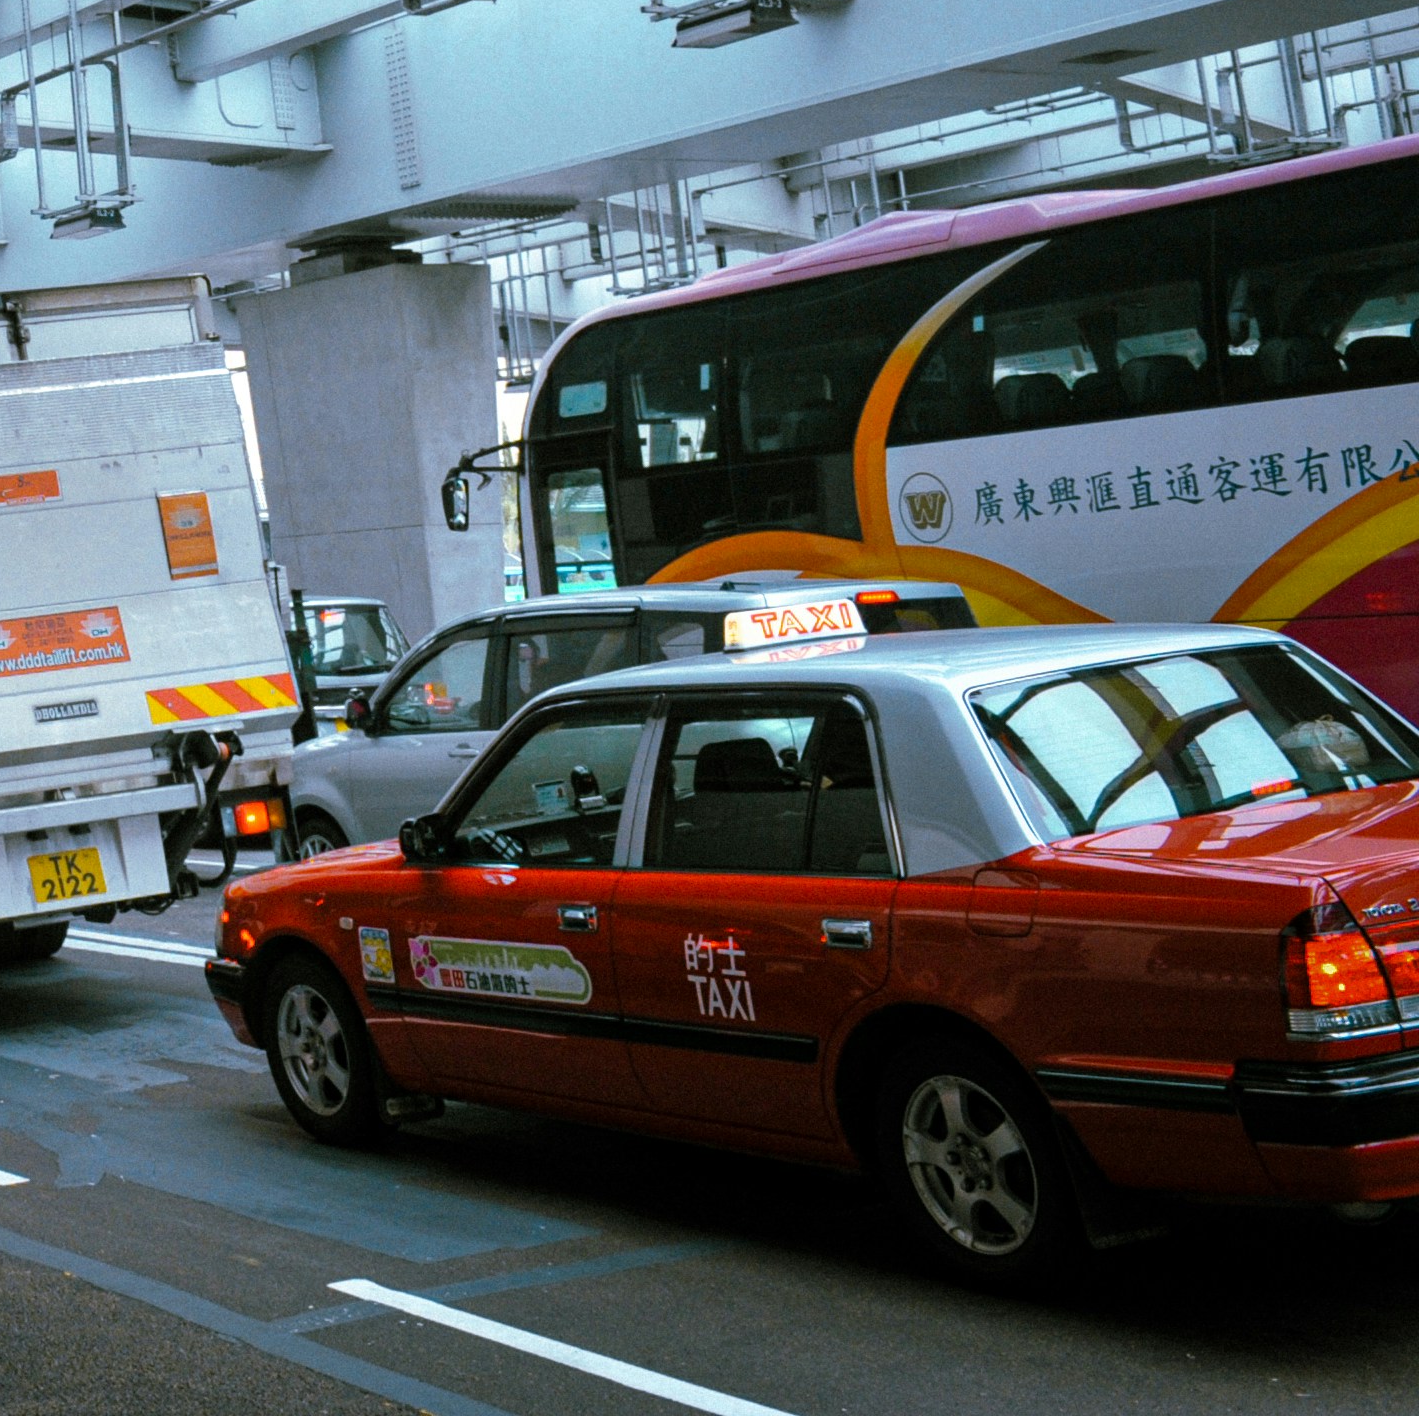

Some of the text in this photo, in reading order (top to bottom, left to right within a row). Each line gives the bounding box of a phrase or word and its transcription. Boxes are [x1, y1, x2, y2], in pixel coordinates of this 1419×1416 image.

[91, 628, 109, 637] DH
[750, 602, 853, 640] TAXI
[34, 701, 100, 721] DHOLLANDIA
[49, 853, 82, 875] TK
[41, 873, 100, 900] 2122
[1361, 903, 1405, 919] TOYOTA
[683, 932, 747, 977] 的士
[687, 974, 757, 1022] TAXI
